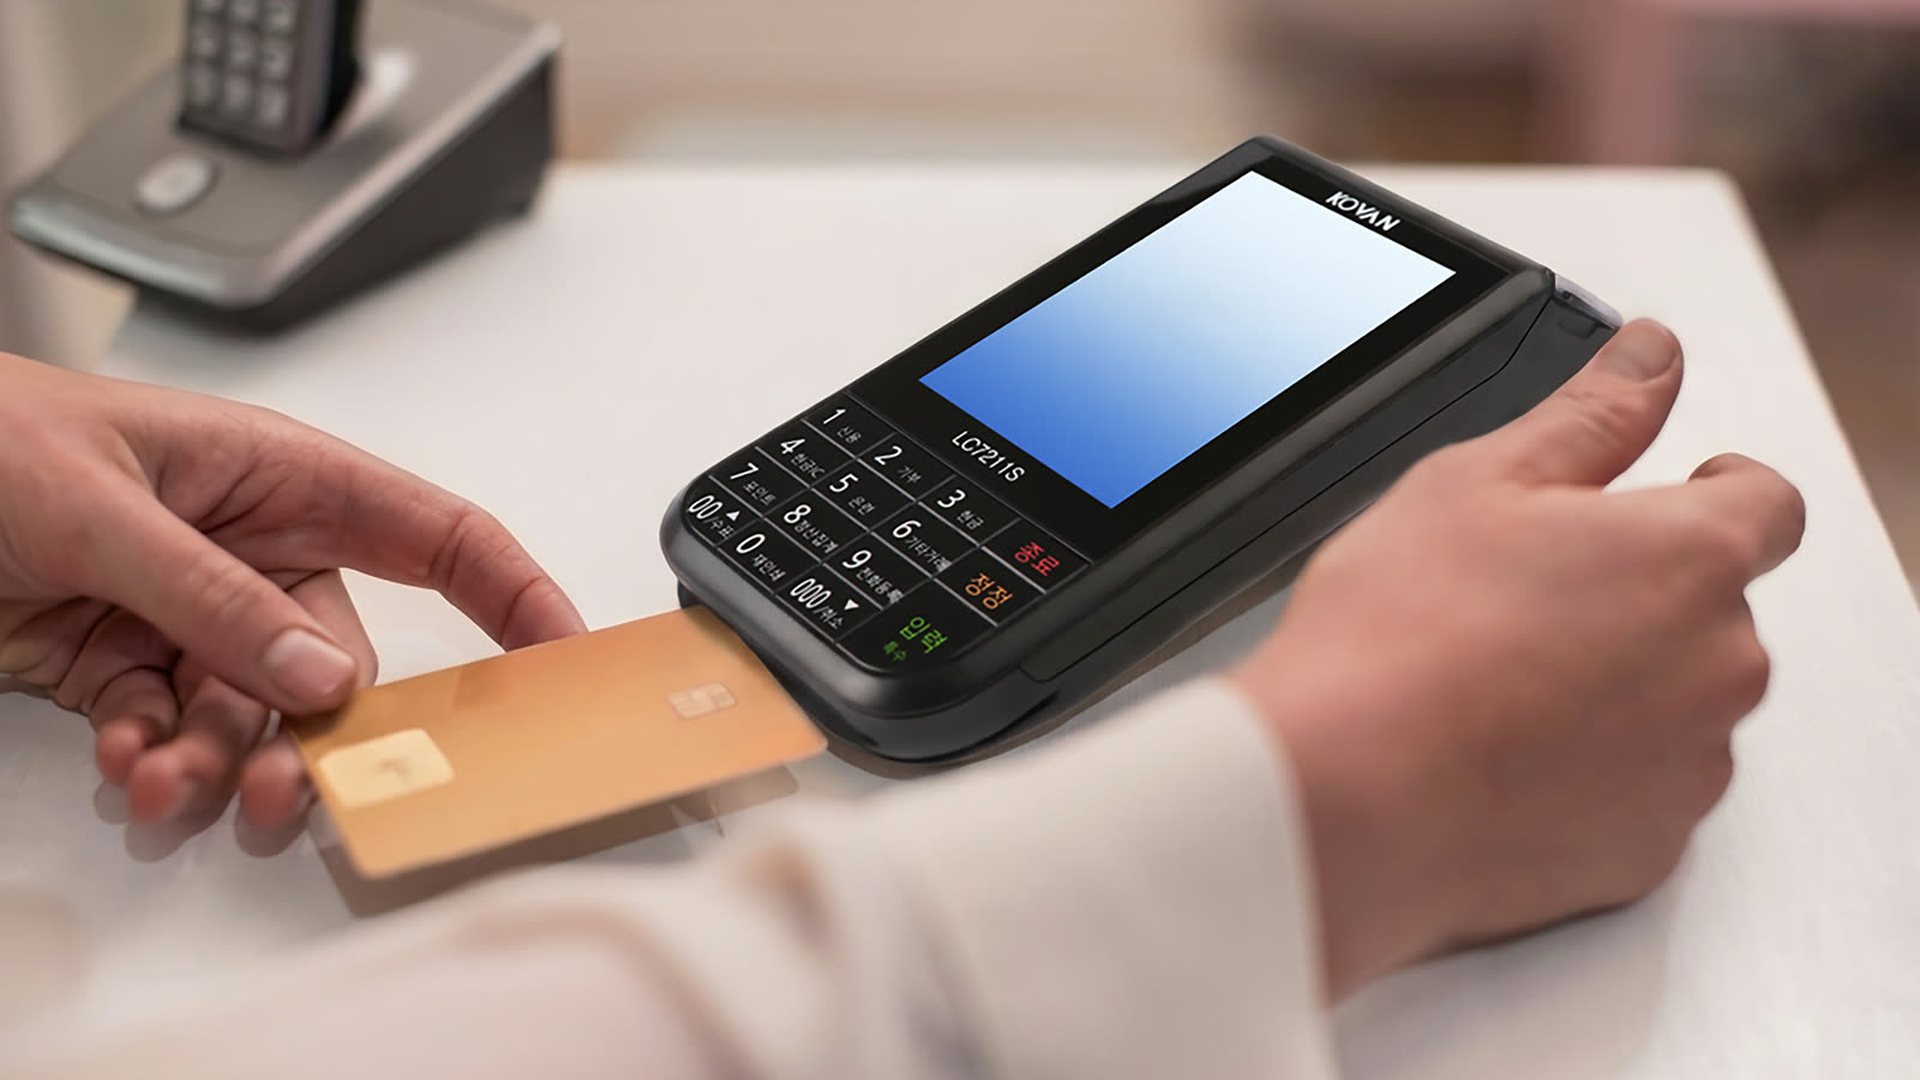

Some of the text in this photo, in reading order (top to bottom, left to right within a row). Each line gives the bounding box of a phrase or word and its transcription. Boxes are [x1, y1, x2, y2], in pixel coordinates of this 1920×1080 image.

[1325, 191, 1401, 231] KOVAN
[823, 408, 847, 425] 1
[780, 438, 806, 455] 4
[874, 446, 903, 466] 2
[951, 430, 1026, 483] LC7211S
[729, 462, 760, 480] 7
[829, 473, 859, 493] 5
[937, 489, 967, 509] 3
[783, 504, 812, 524] 8
[892, 519, 922, 539] 6
[735, 533, 766, 554] 0
[842, 550, 873, 569] 9
[1014, 541, 1061, 577] 종료
[964, 572, 1014, 610] 정정
[900, 617, 949, 655] 입력
